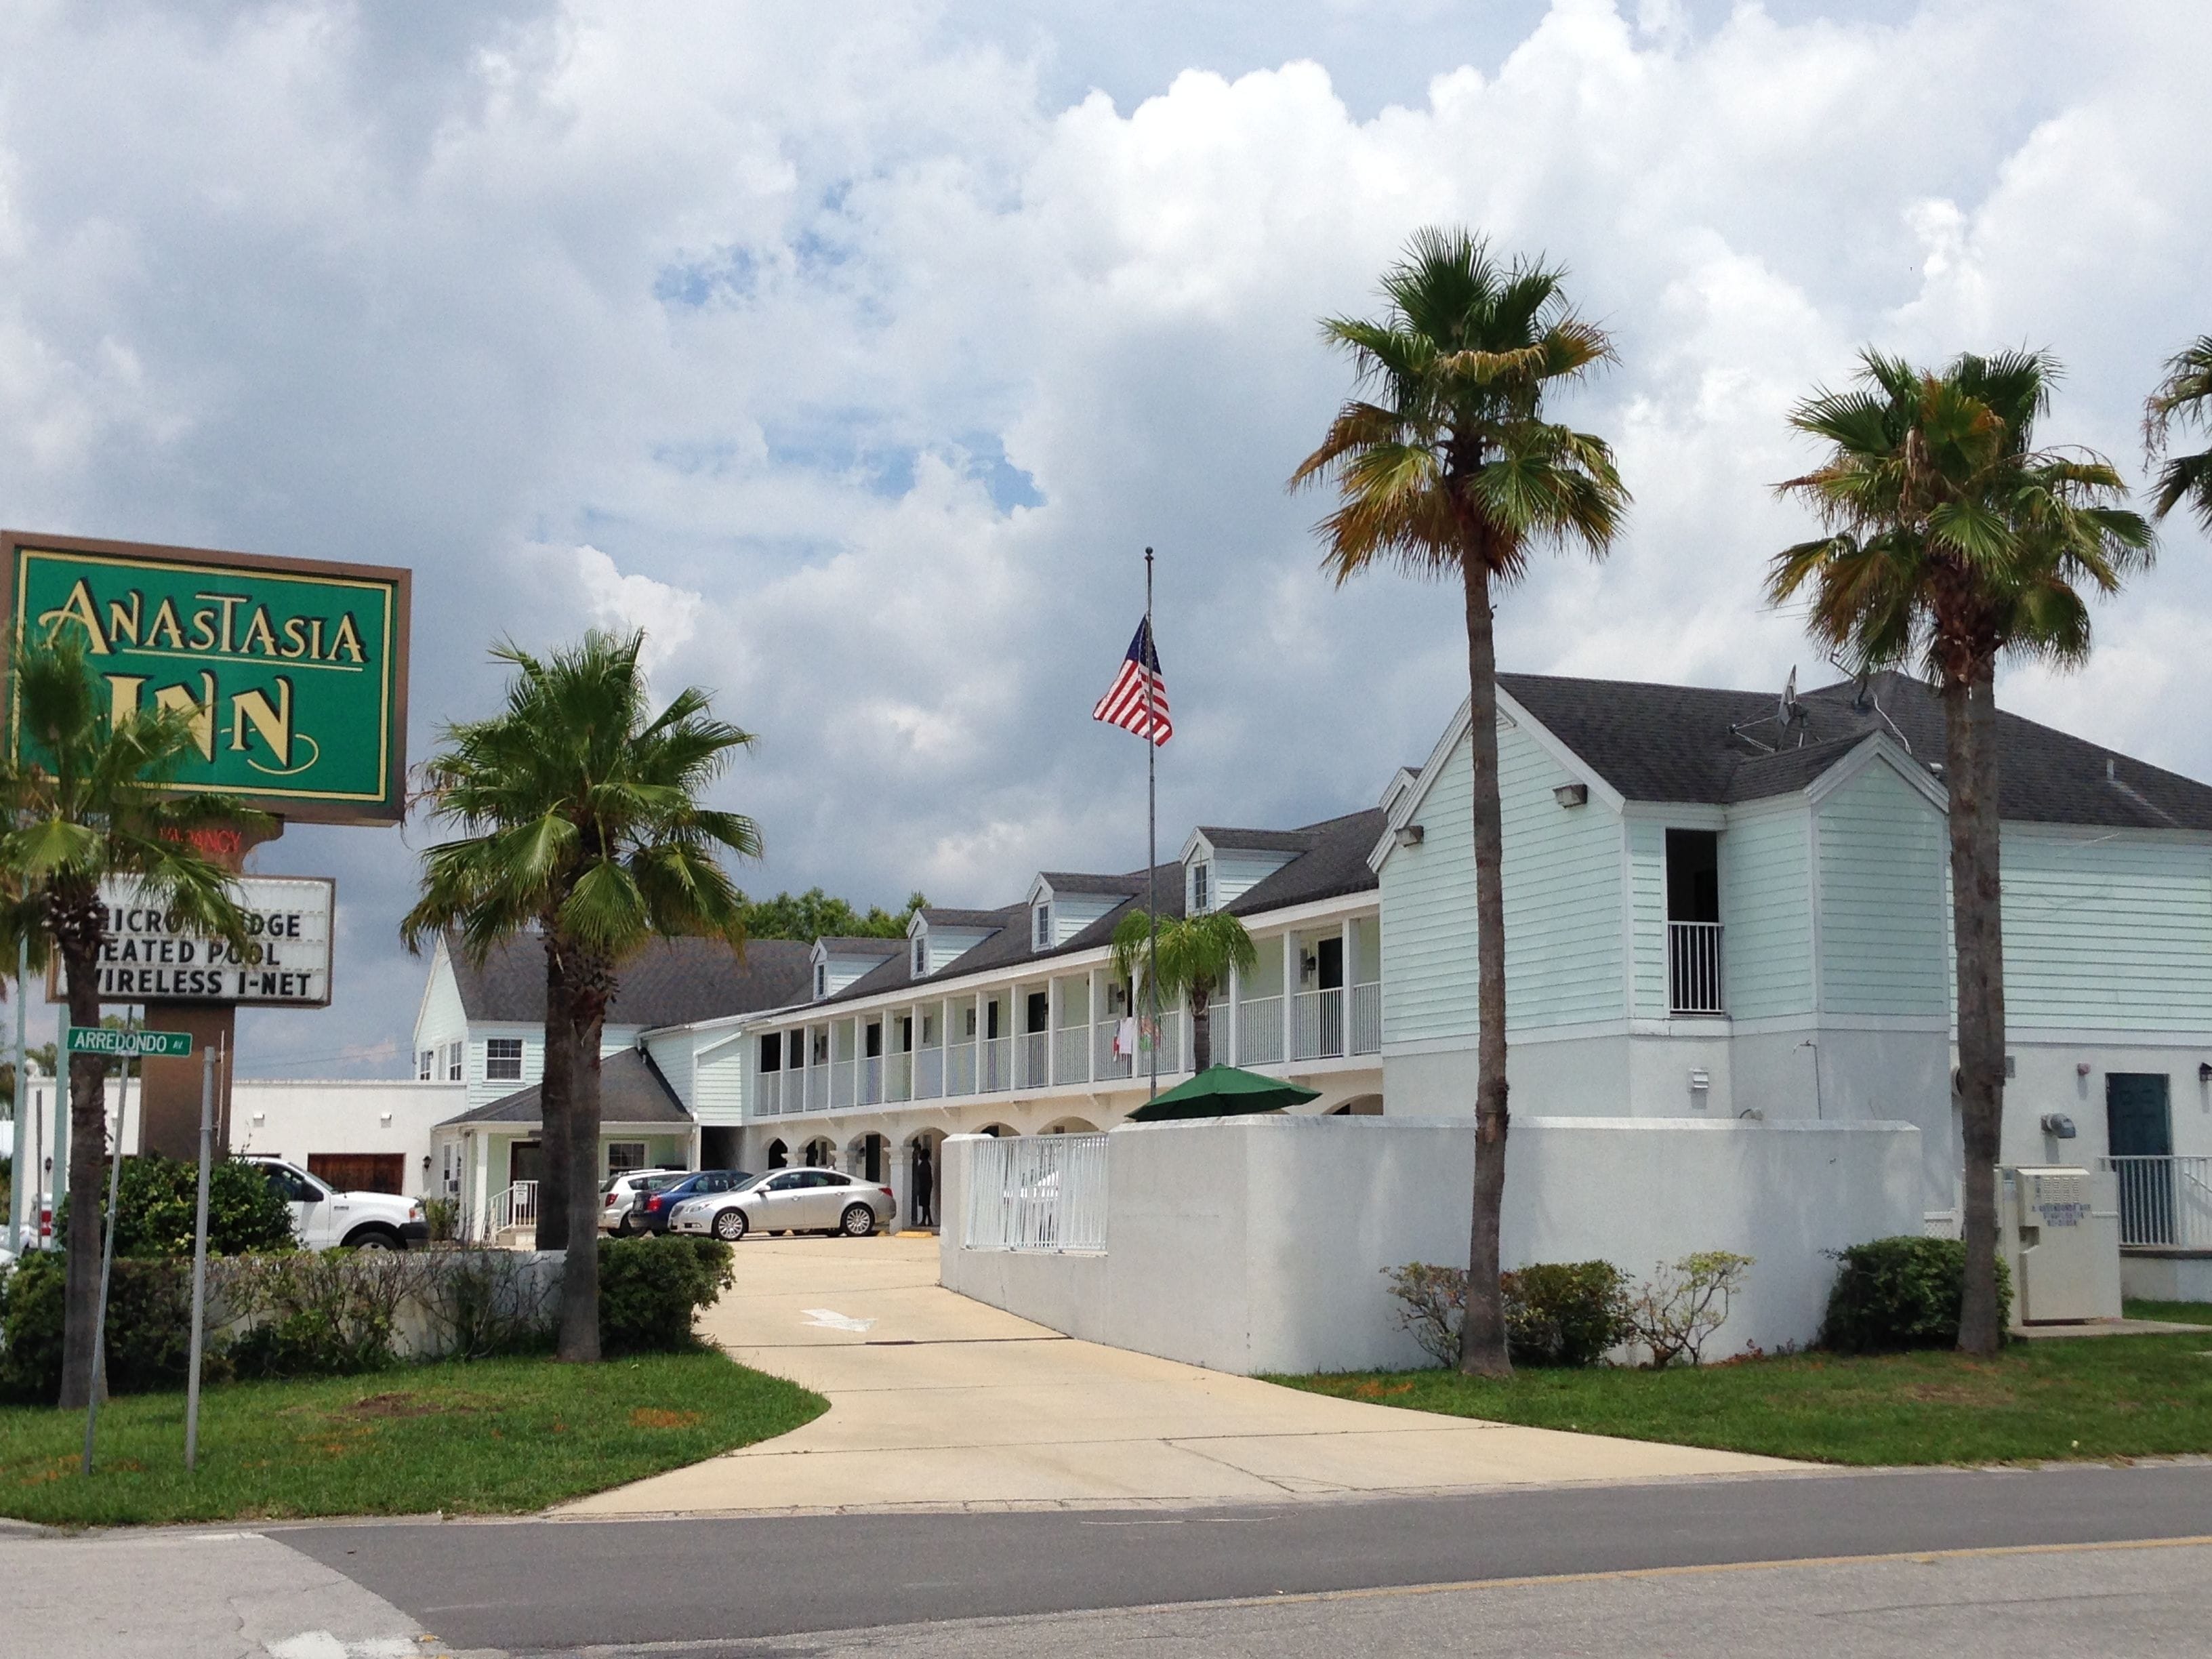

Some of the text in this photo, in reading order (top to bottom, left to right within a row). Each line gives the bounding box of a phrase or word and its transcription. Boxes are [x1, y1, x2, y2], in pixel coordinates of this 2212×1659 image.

[38, 577, 369, 663] ANASTASIA
[103, 668, 293, 767] INN
[102, 907, 184, 933] ICRO
[97, 938, 194, 963] EATED
[96, 968, 310, 996] IRELESS I-NET
[74, 1031, 167, 1052] ARREDONDO
